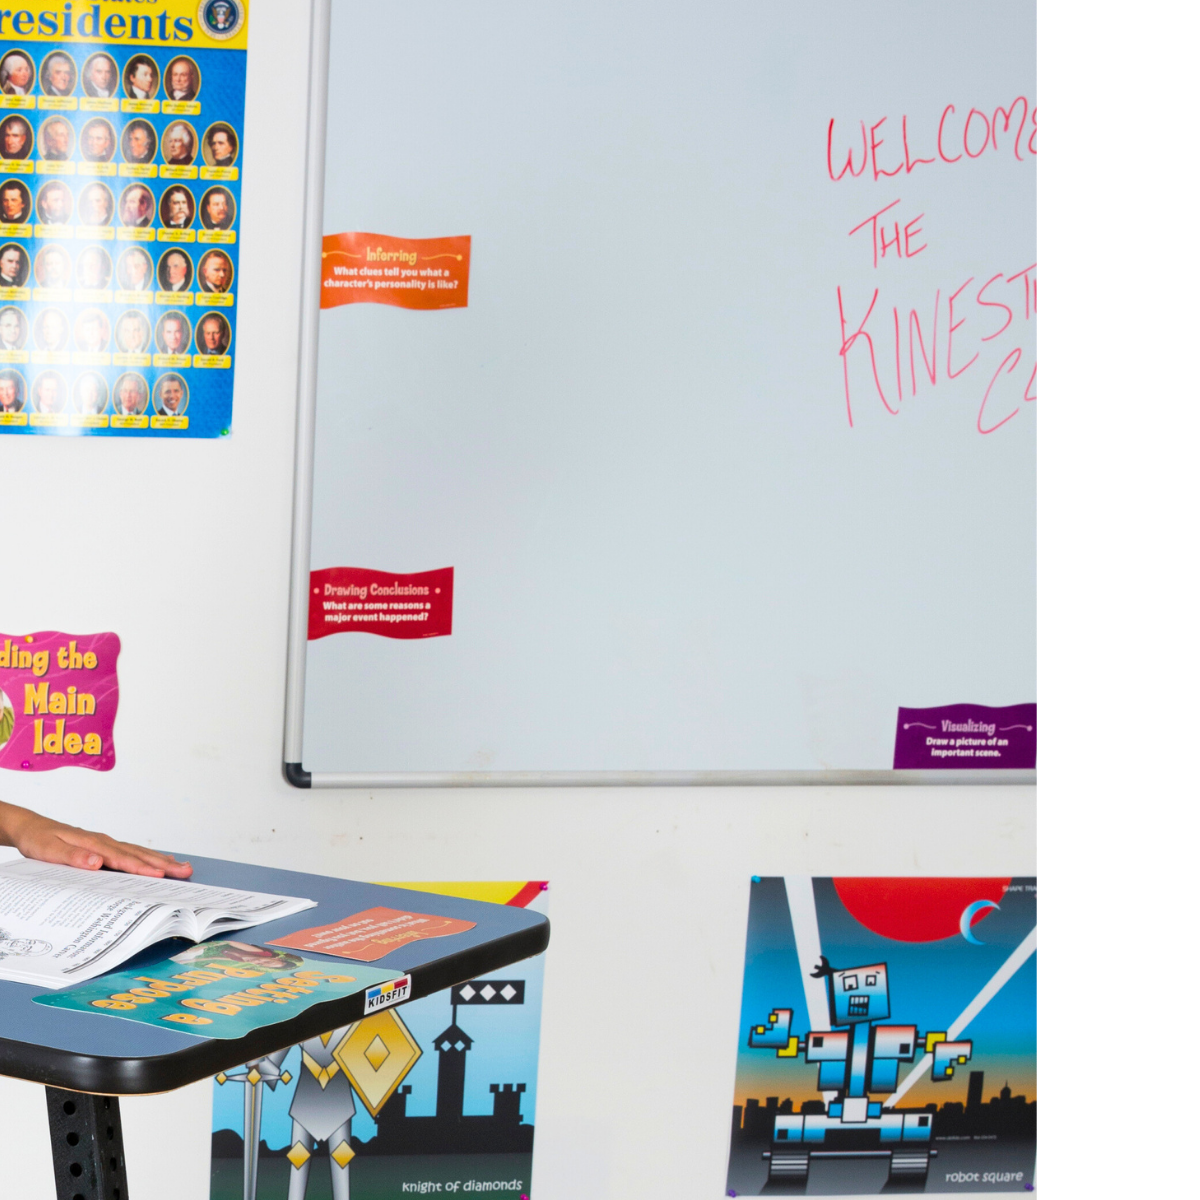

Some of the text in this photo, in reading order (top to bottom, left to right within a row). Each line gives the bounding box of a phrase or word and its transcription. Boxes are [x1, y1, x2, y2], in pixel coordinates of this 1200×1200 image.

[848, 198, 927, 268] THE
[366, 246, 418, 266] Inferring
[334, 266, 442, 278] What clues tell you what
[323, 278, 459, 290] character's personality like?
[324, 581, 430, 600] Drawing Conclusions
[323, 601, 424, 610] What are some reasons
[325, 612, 429, 624] major event happened?
[56, 640, 98, 669] the
[23, 681, 96, 715] Main
[941, 718, 996, 736] Visualizing
[32, 718, 102, 755] Idea
[926, 737, 986, 747] Draw picture
[931, 747, 1001, 758] important scene.
[90, 962, 266, 1011] Purpose
[159, 970, 358, 1025] Setting a
[368, 986, 408, 1009] KIDSFIT
[463, 1179, 523, 1192] diamonds
[945, 1171, 1024, 1184] robot square
